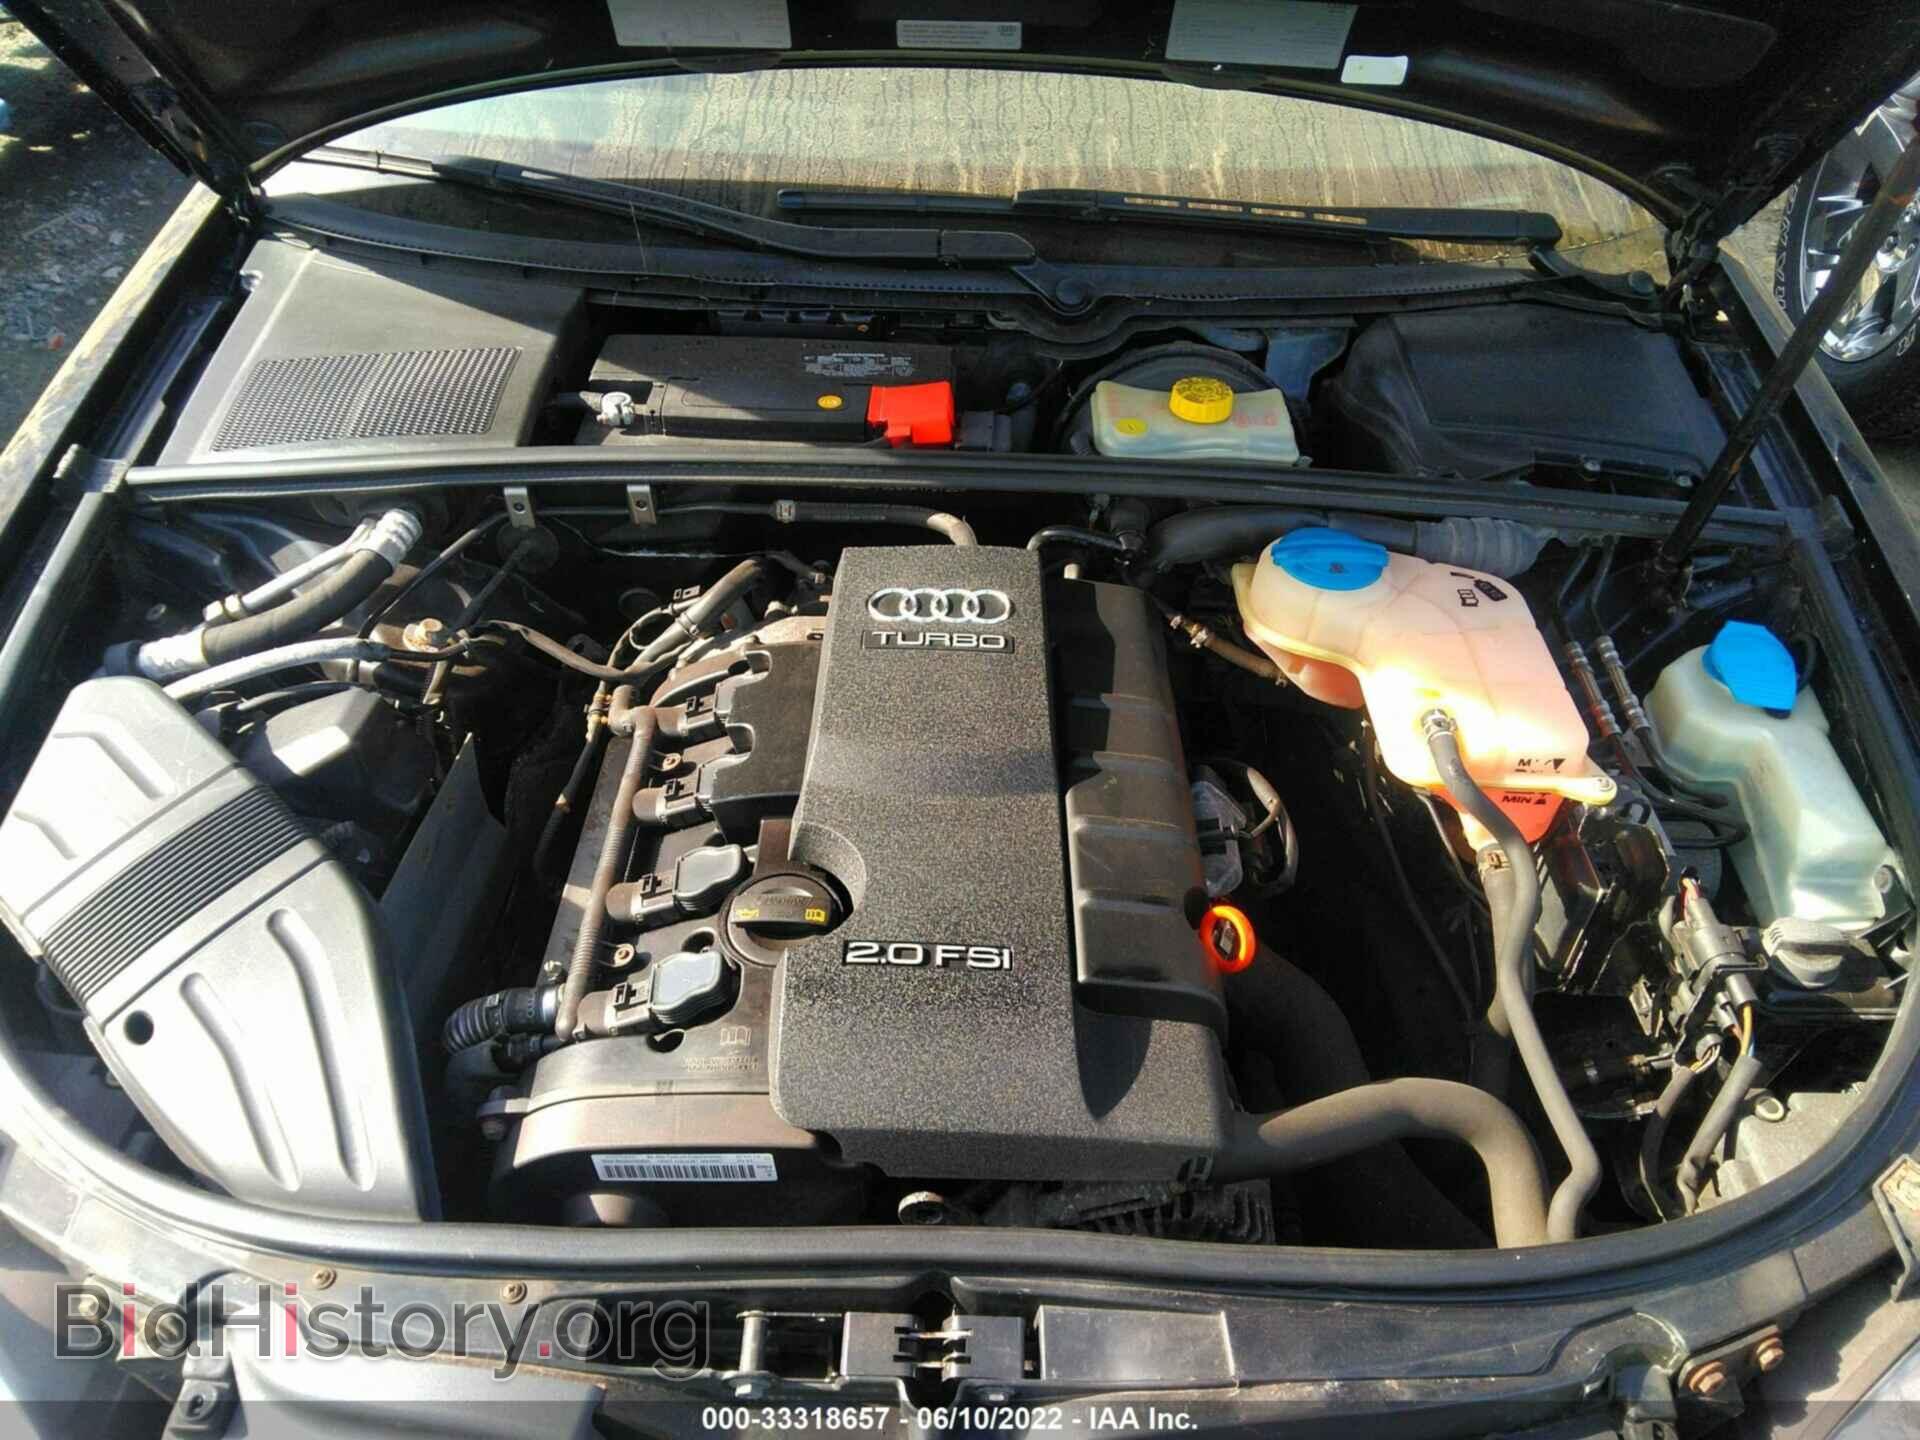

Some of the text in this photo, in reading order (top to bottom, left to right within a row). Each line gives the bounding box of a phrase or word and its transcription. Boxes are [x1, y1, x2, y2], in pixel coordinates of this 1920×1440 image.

[872, 631, 1005, 649] TURBO
[1502, 795, 1532, 804] MIN
[846, 941, 1012, 970] 2.0 FSI
